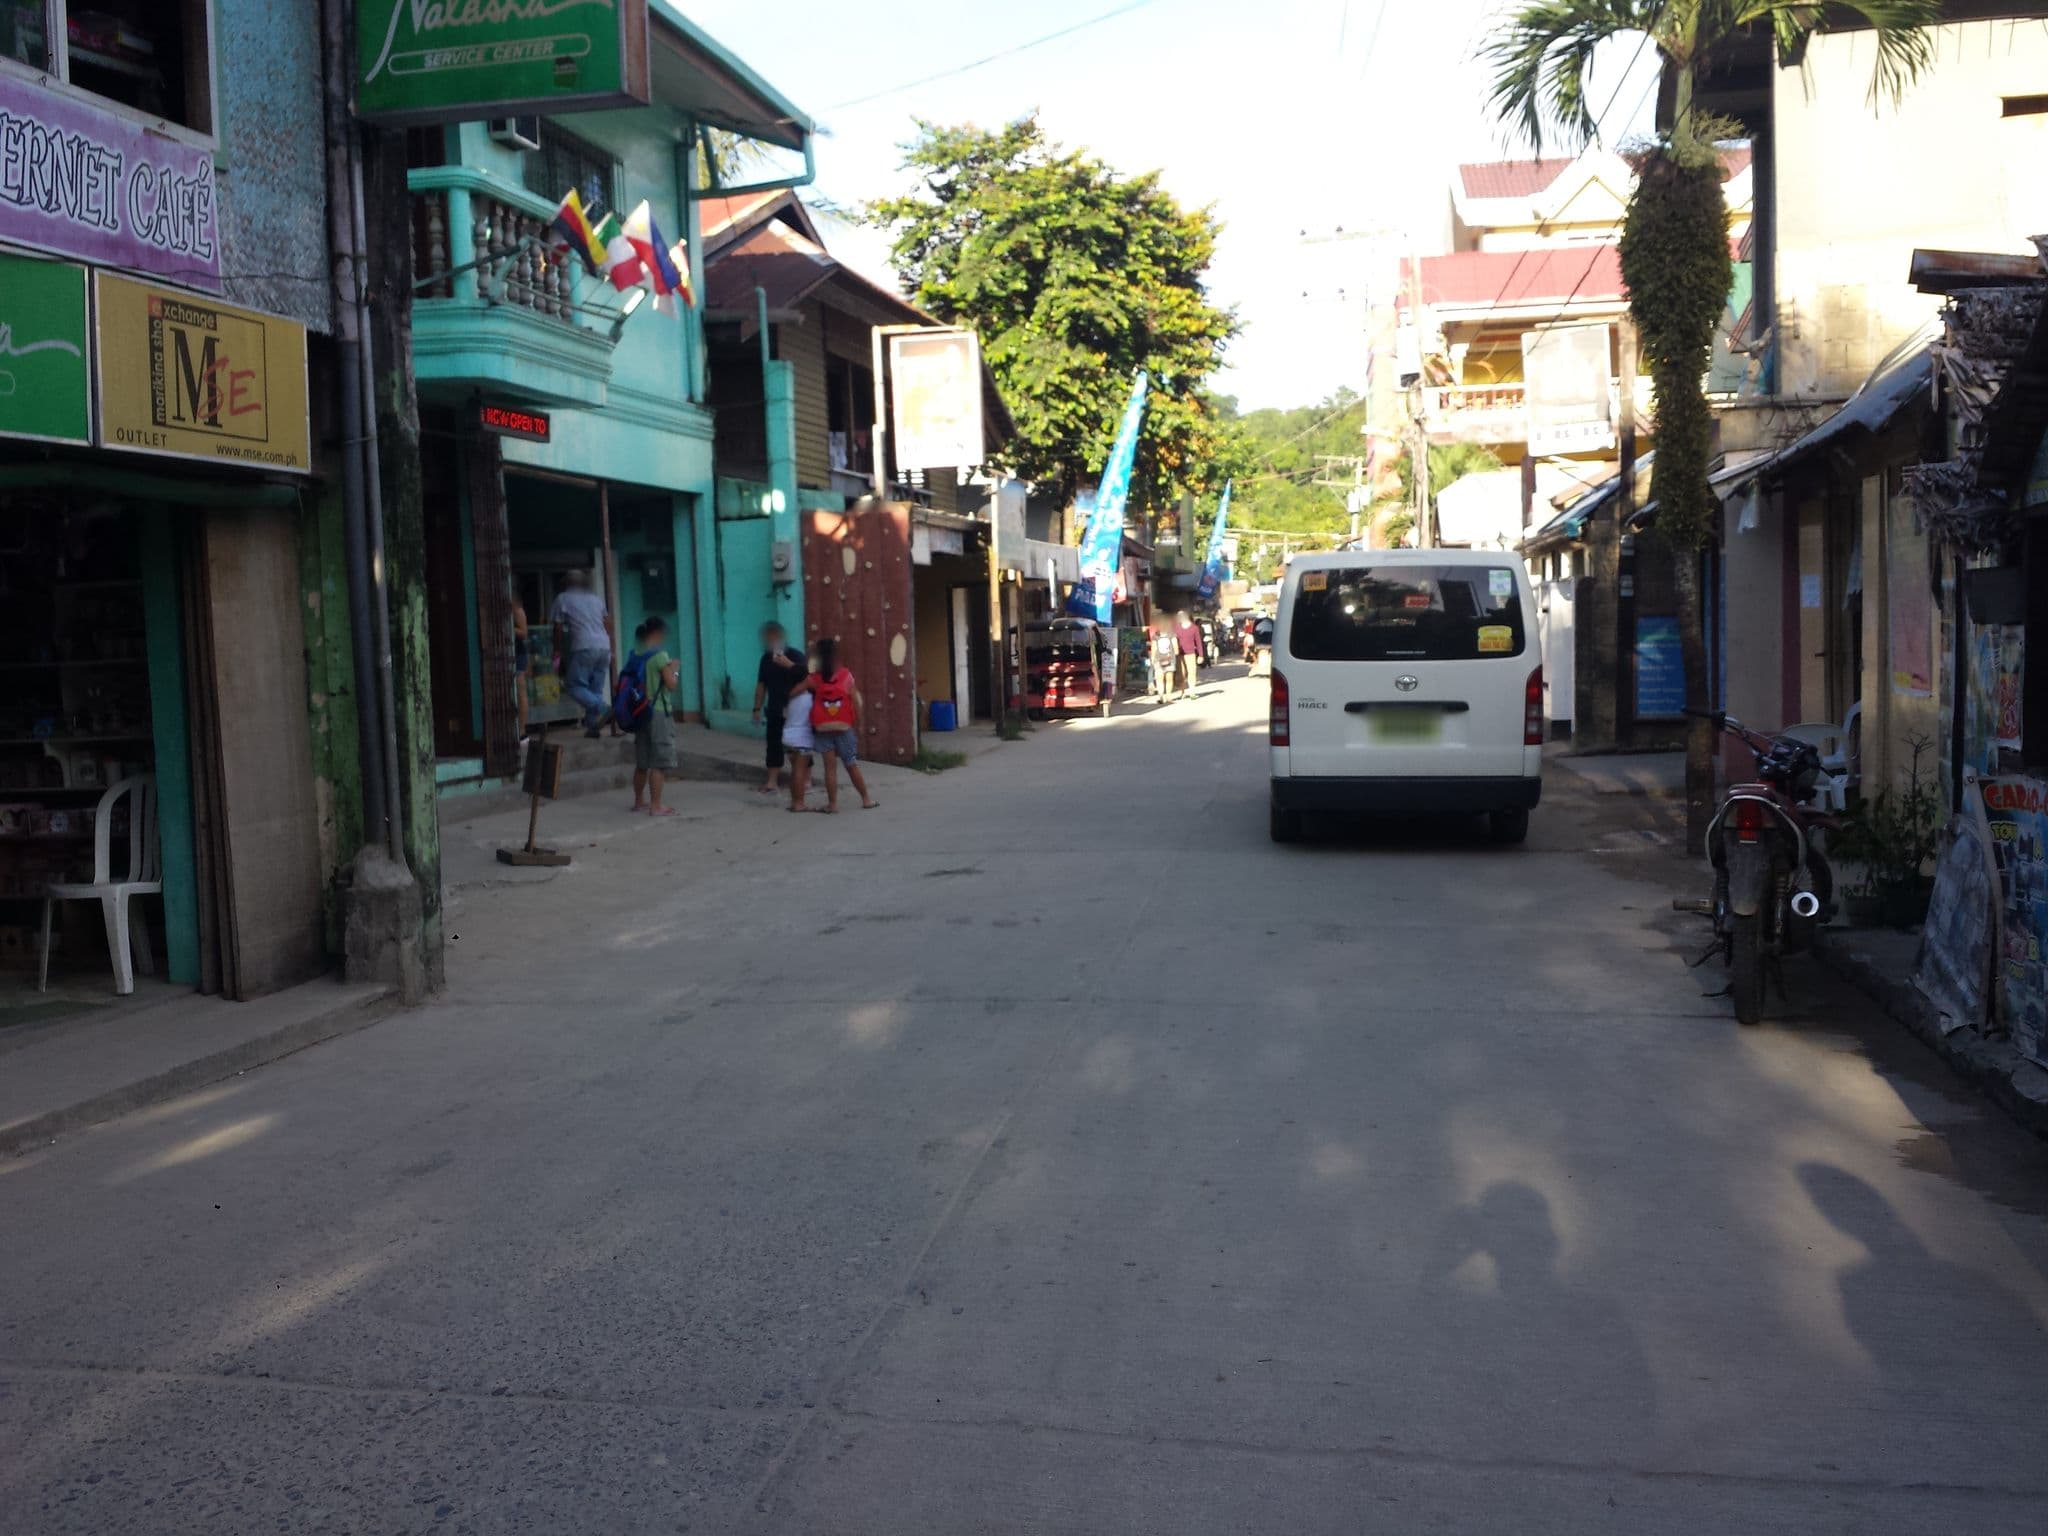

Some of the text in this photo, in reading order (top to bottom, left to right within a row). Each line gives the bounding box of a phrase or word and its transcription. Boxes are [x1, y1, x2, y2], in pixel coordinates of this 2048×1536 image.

[424, 40, 555, 69] SERVICE CENTER
[128, 159, 212, 259] CAFÉ
[149, 297, 217, 330] exchange
[151, 353, 166, 423] marikina
[116, 427, 168, 448] OUTLET
[216, 443, 298, 467] www.mse.com.ph
